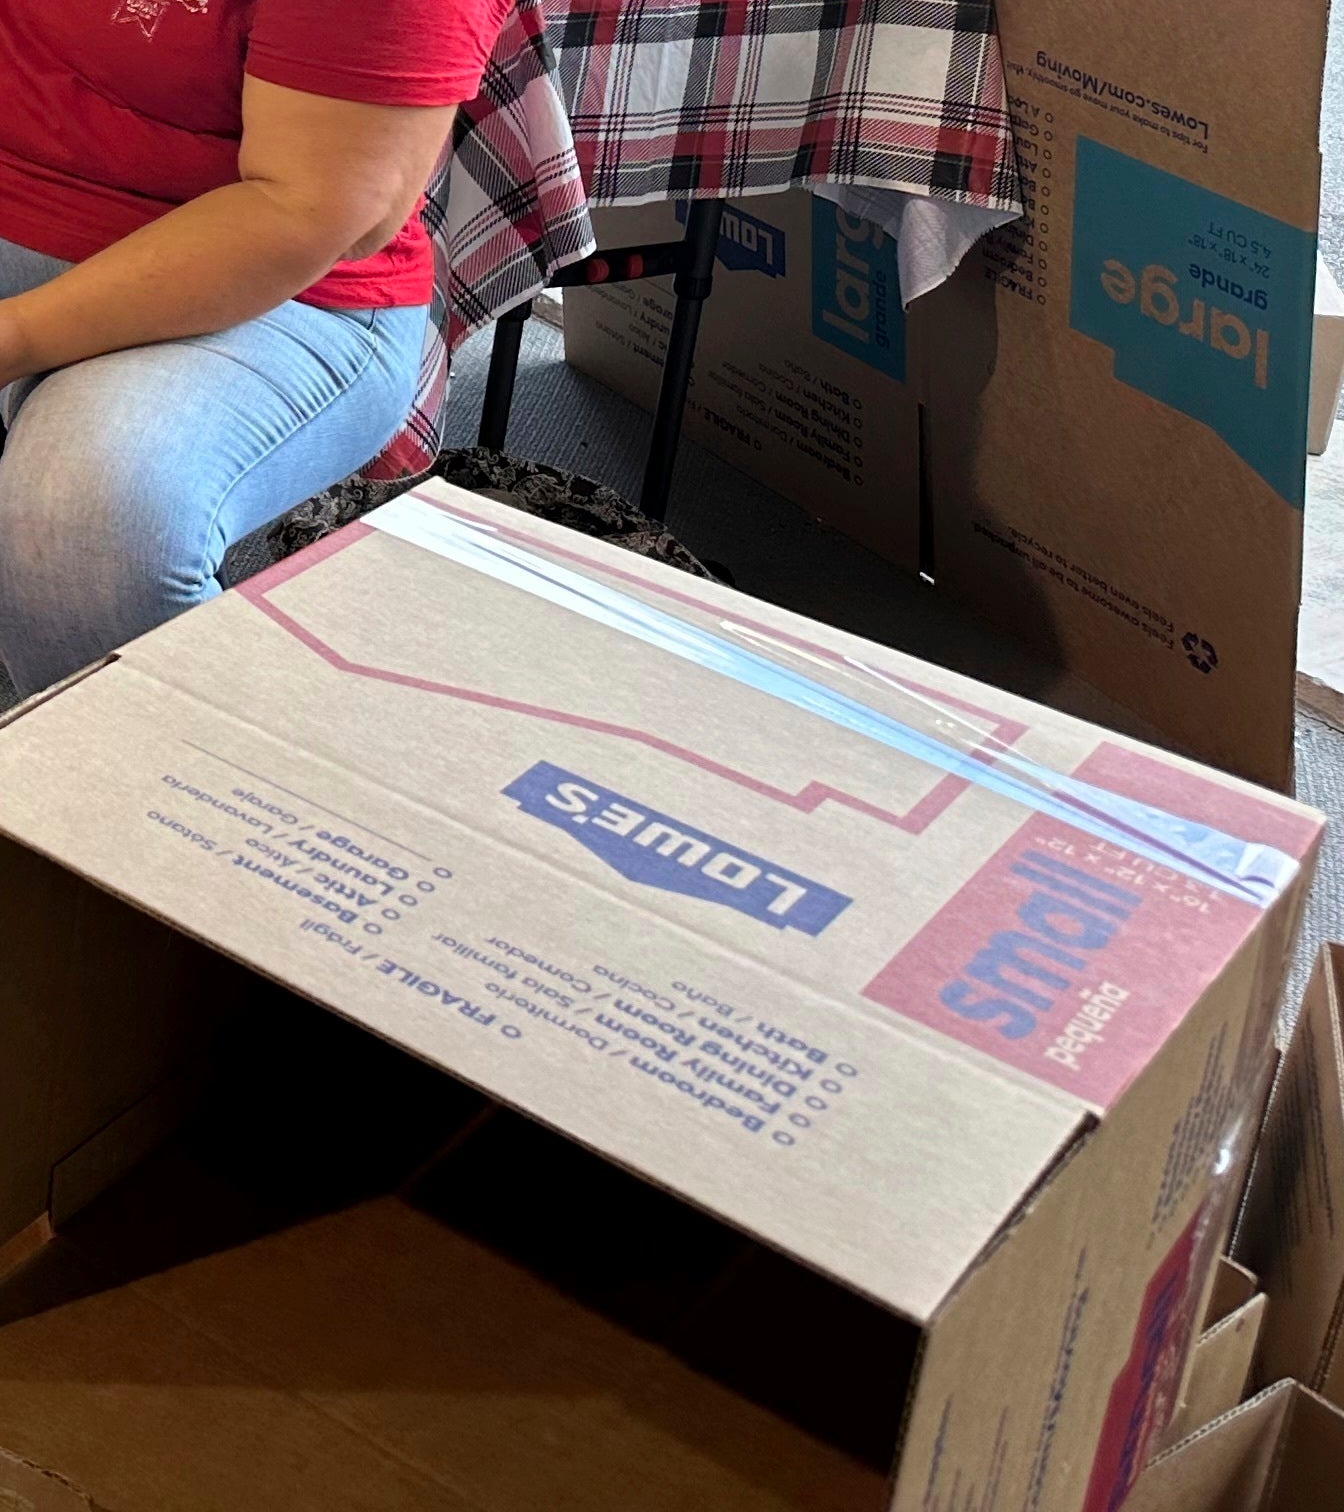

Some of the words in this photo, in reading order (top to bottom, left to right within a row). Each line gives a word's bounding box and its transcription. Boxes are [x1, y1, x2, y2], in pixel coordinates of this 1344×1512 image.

[1036, 50, 1210, 140] Lowes.com/Moving
[1187, 261, 1269, 311] grande
[1100, 258, 1270, 391] large
[231, 787, 300, 826] Garaje
[287, 837, 396, 897] Laundry
[316, 829, 410, 882] Garage
[546, 777, 807, 917] LOWE'S
[231, 854, 360, 925] Basement
[313, 872, 378, 908] Attic
[432, 931, 521, 981] familiar
[485, 934, 594, 993] Comedor
[937, 848, 1143, 1040] small
[375, 957, 496, 1028] FRAGILE
[483, 980, 610, 1051] Dormitorio
[522, 975, 575, 1015] Sala
[592, 963, 677, 1013] Cocina
[671, 979, 736, 1018] Baño
[594, 1011, 679, 1064] Room
[613, 998, 696, 1049] Room
[697, 1014, 814, 1081] Kitchen
[755, 1021, 829, 1065] Bath
[1043, 979, 1131, 1071] pequeña
[630, 1055, 766, 1134] Bedroom
[682, 1056, 782, 1116] Family
[700, 1039, 799, 1099] Dining
